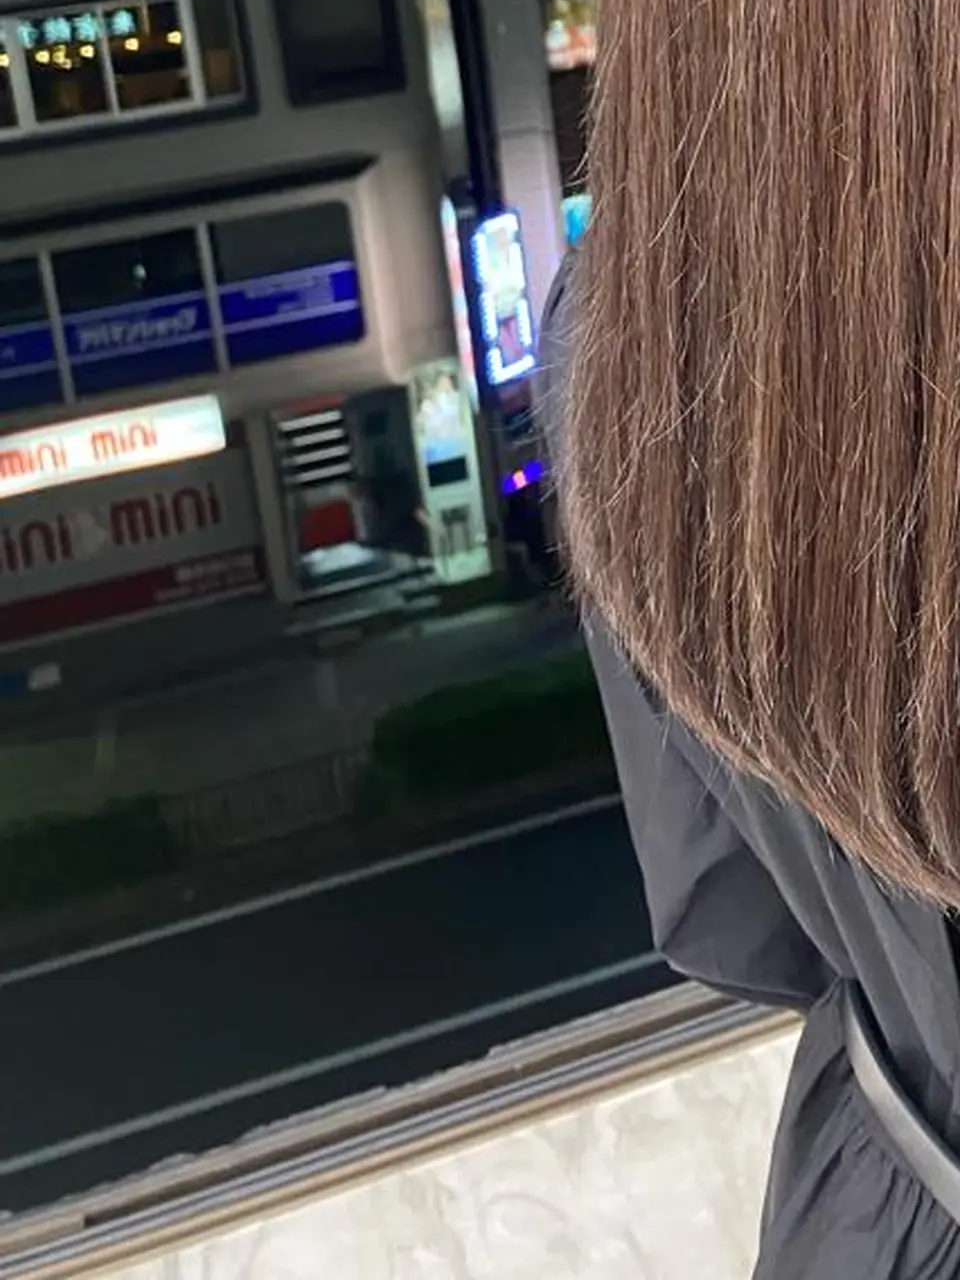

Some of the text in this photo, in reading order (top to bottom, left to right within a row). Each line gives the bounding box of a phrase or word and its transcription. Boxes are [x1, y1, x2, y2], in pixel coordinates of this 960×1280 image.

[0, 417, 158, 479] mini mini
[0, 481, 221, 573] ini mini
